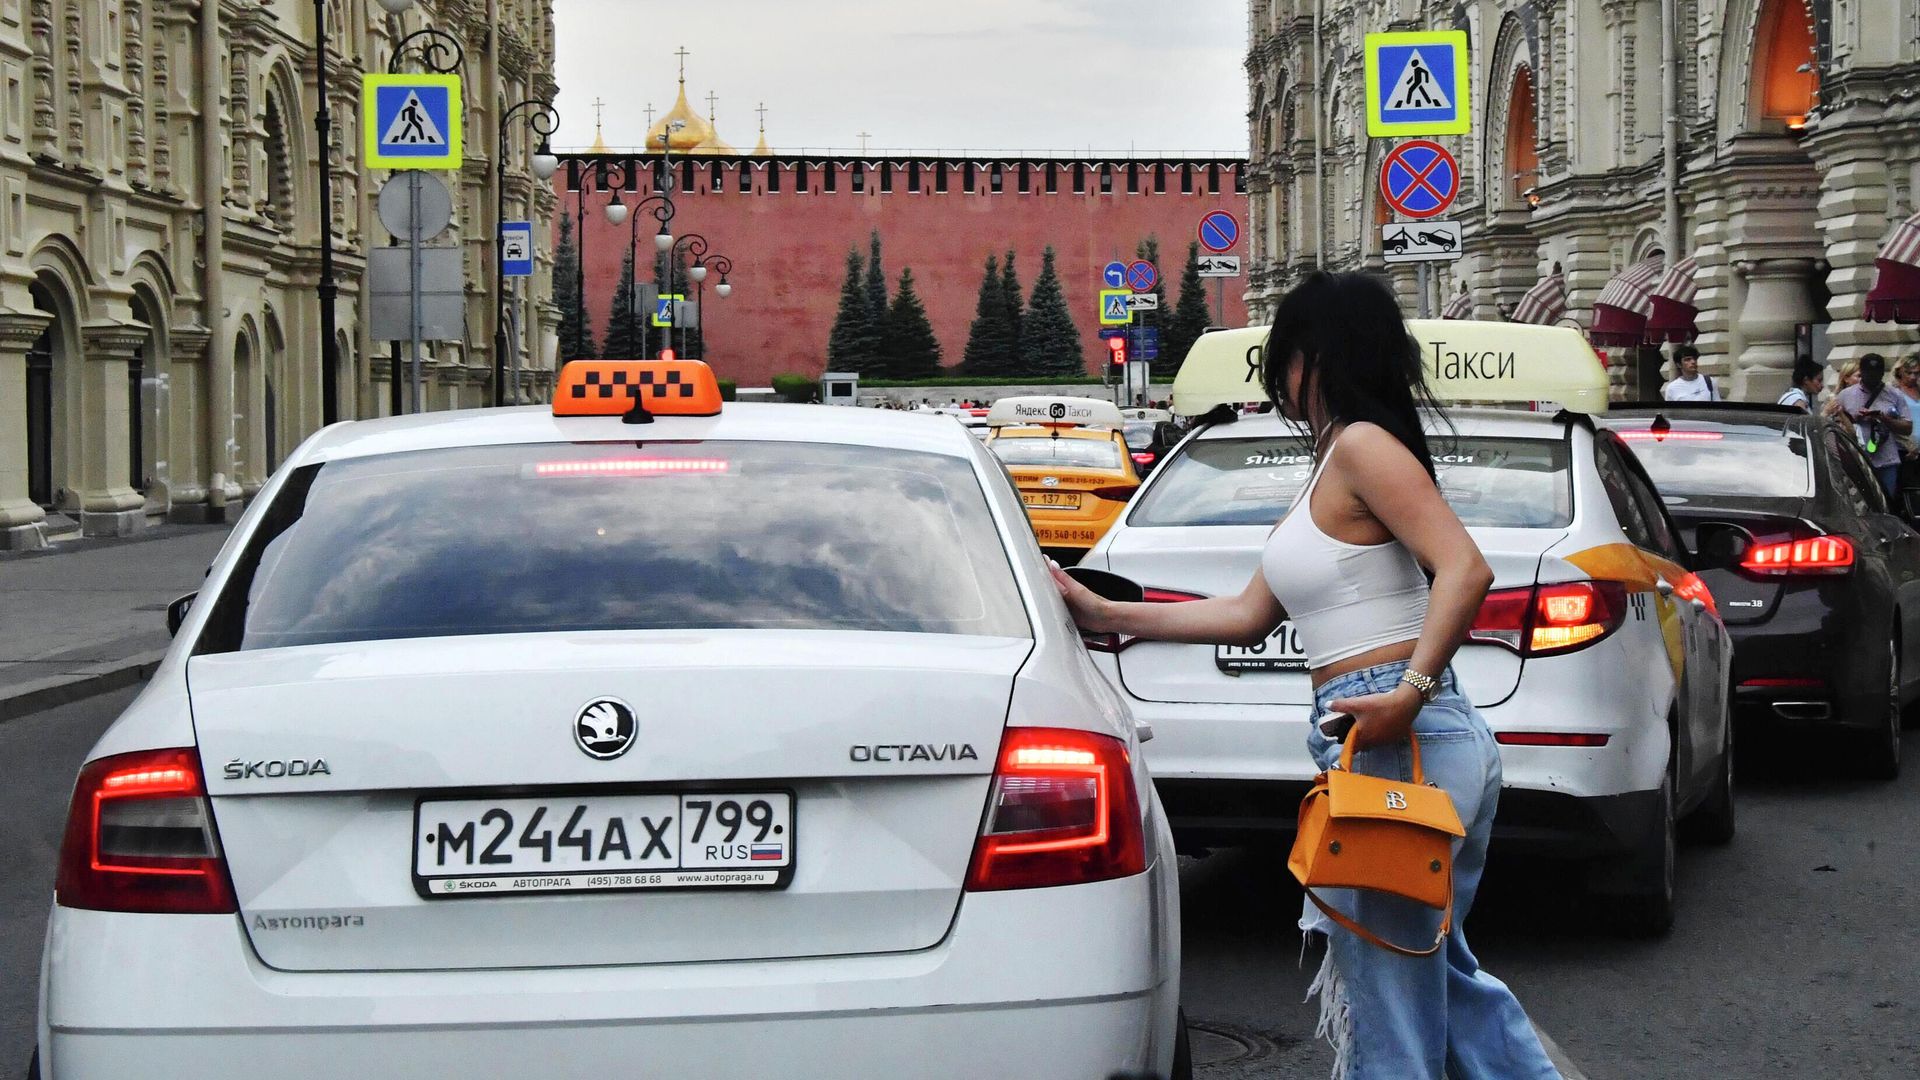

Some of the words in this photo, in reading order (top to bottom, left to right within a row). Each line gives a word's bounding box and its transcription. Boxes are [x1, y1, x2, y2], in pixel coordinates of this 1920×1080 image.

[1428, 341, 1516, 380] Такси
[1015, 404, 1047, 416] Яндекс
[1050, 403, 1065, 418] Go
[1068, 405, 1092, 417] Такси
[1244, 455, 1311, 465] Янде
[1042, 493, 1060, 504] 137
[1067, 494, 1078, 503] 99
[849, 743, 979, 762] OCTAVIA
[436, 804, 674, 866] М244АХ
[685, 799, 774, 844] 799
[705, 844, 749, 861] RUS
[512, 878, 572, 888] АВТОПРАГА
[587, 876, 612, 887] (495)
[614, 876, 632, 885] 788
[634, 875, 647, 884] 68
[649, 875, 662, 884] 68
[676, 873, 765, 883] www.autopraga.ru
[253, 914, 365, 932] Автопрага
